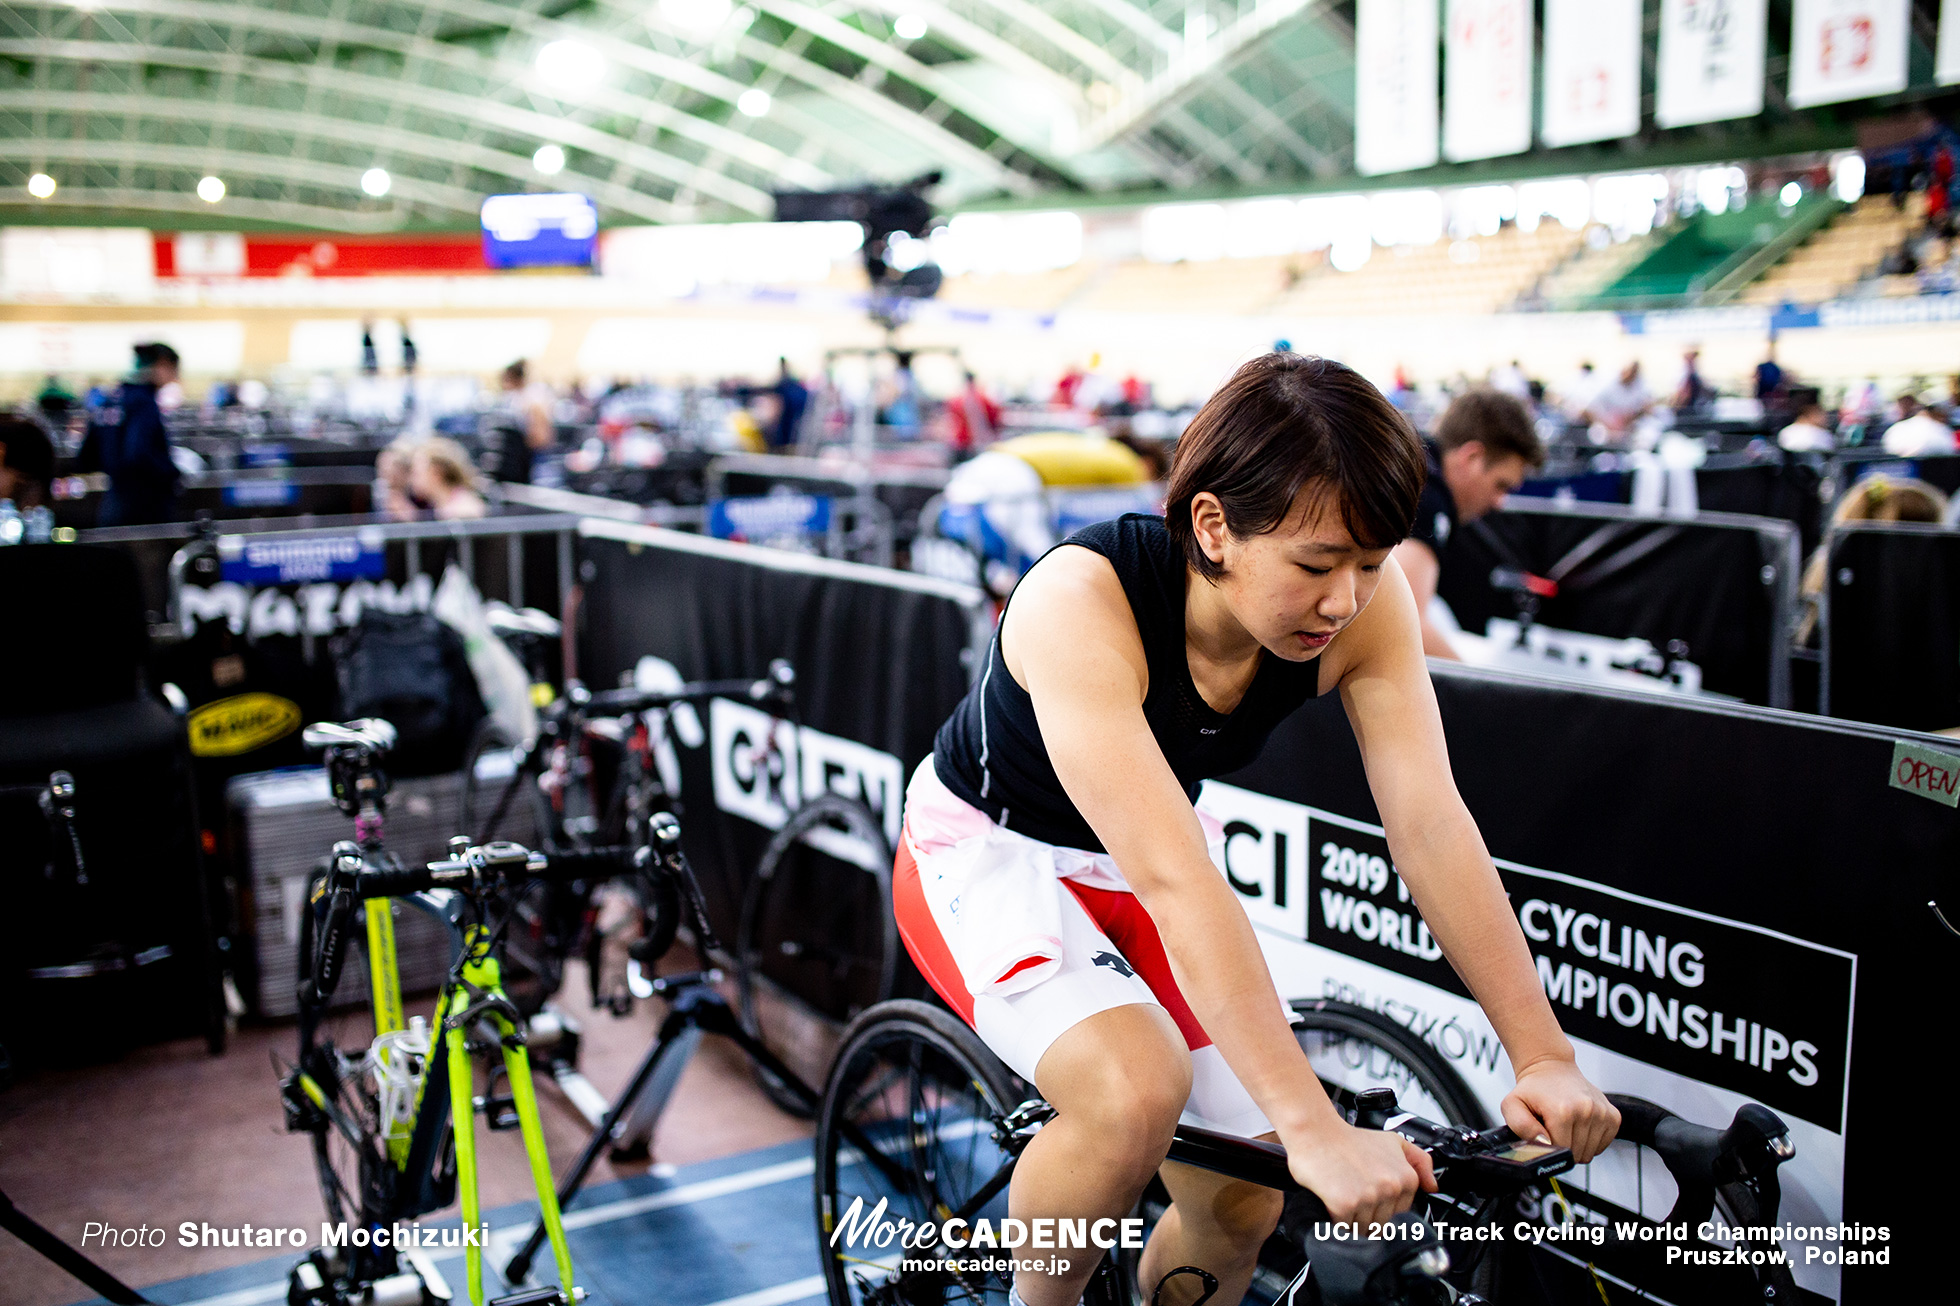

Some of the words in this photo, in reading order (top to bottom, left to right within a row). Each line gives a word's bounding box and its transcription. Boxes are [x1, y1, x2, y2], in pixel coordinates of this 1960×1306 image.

[1897, 756, 1960, 796] OPEN
[1223, 820, 1287, 909] CI
[1321, 842, 1389, 896] 2019
[1520, 899, 1705, 988] CYCLING
[1320, 888, 1444, 962] WORLD
[1536, 954, 1820, 1087] MPIONSHIPS
[1537, 1161, 1568, 1176] Pioneer
